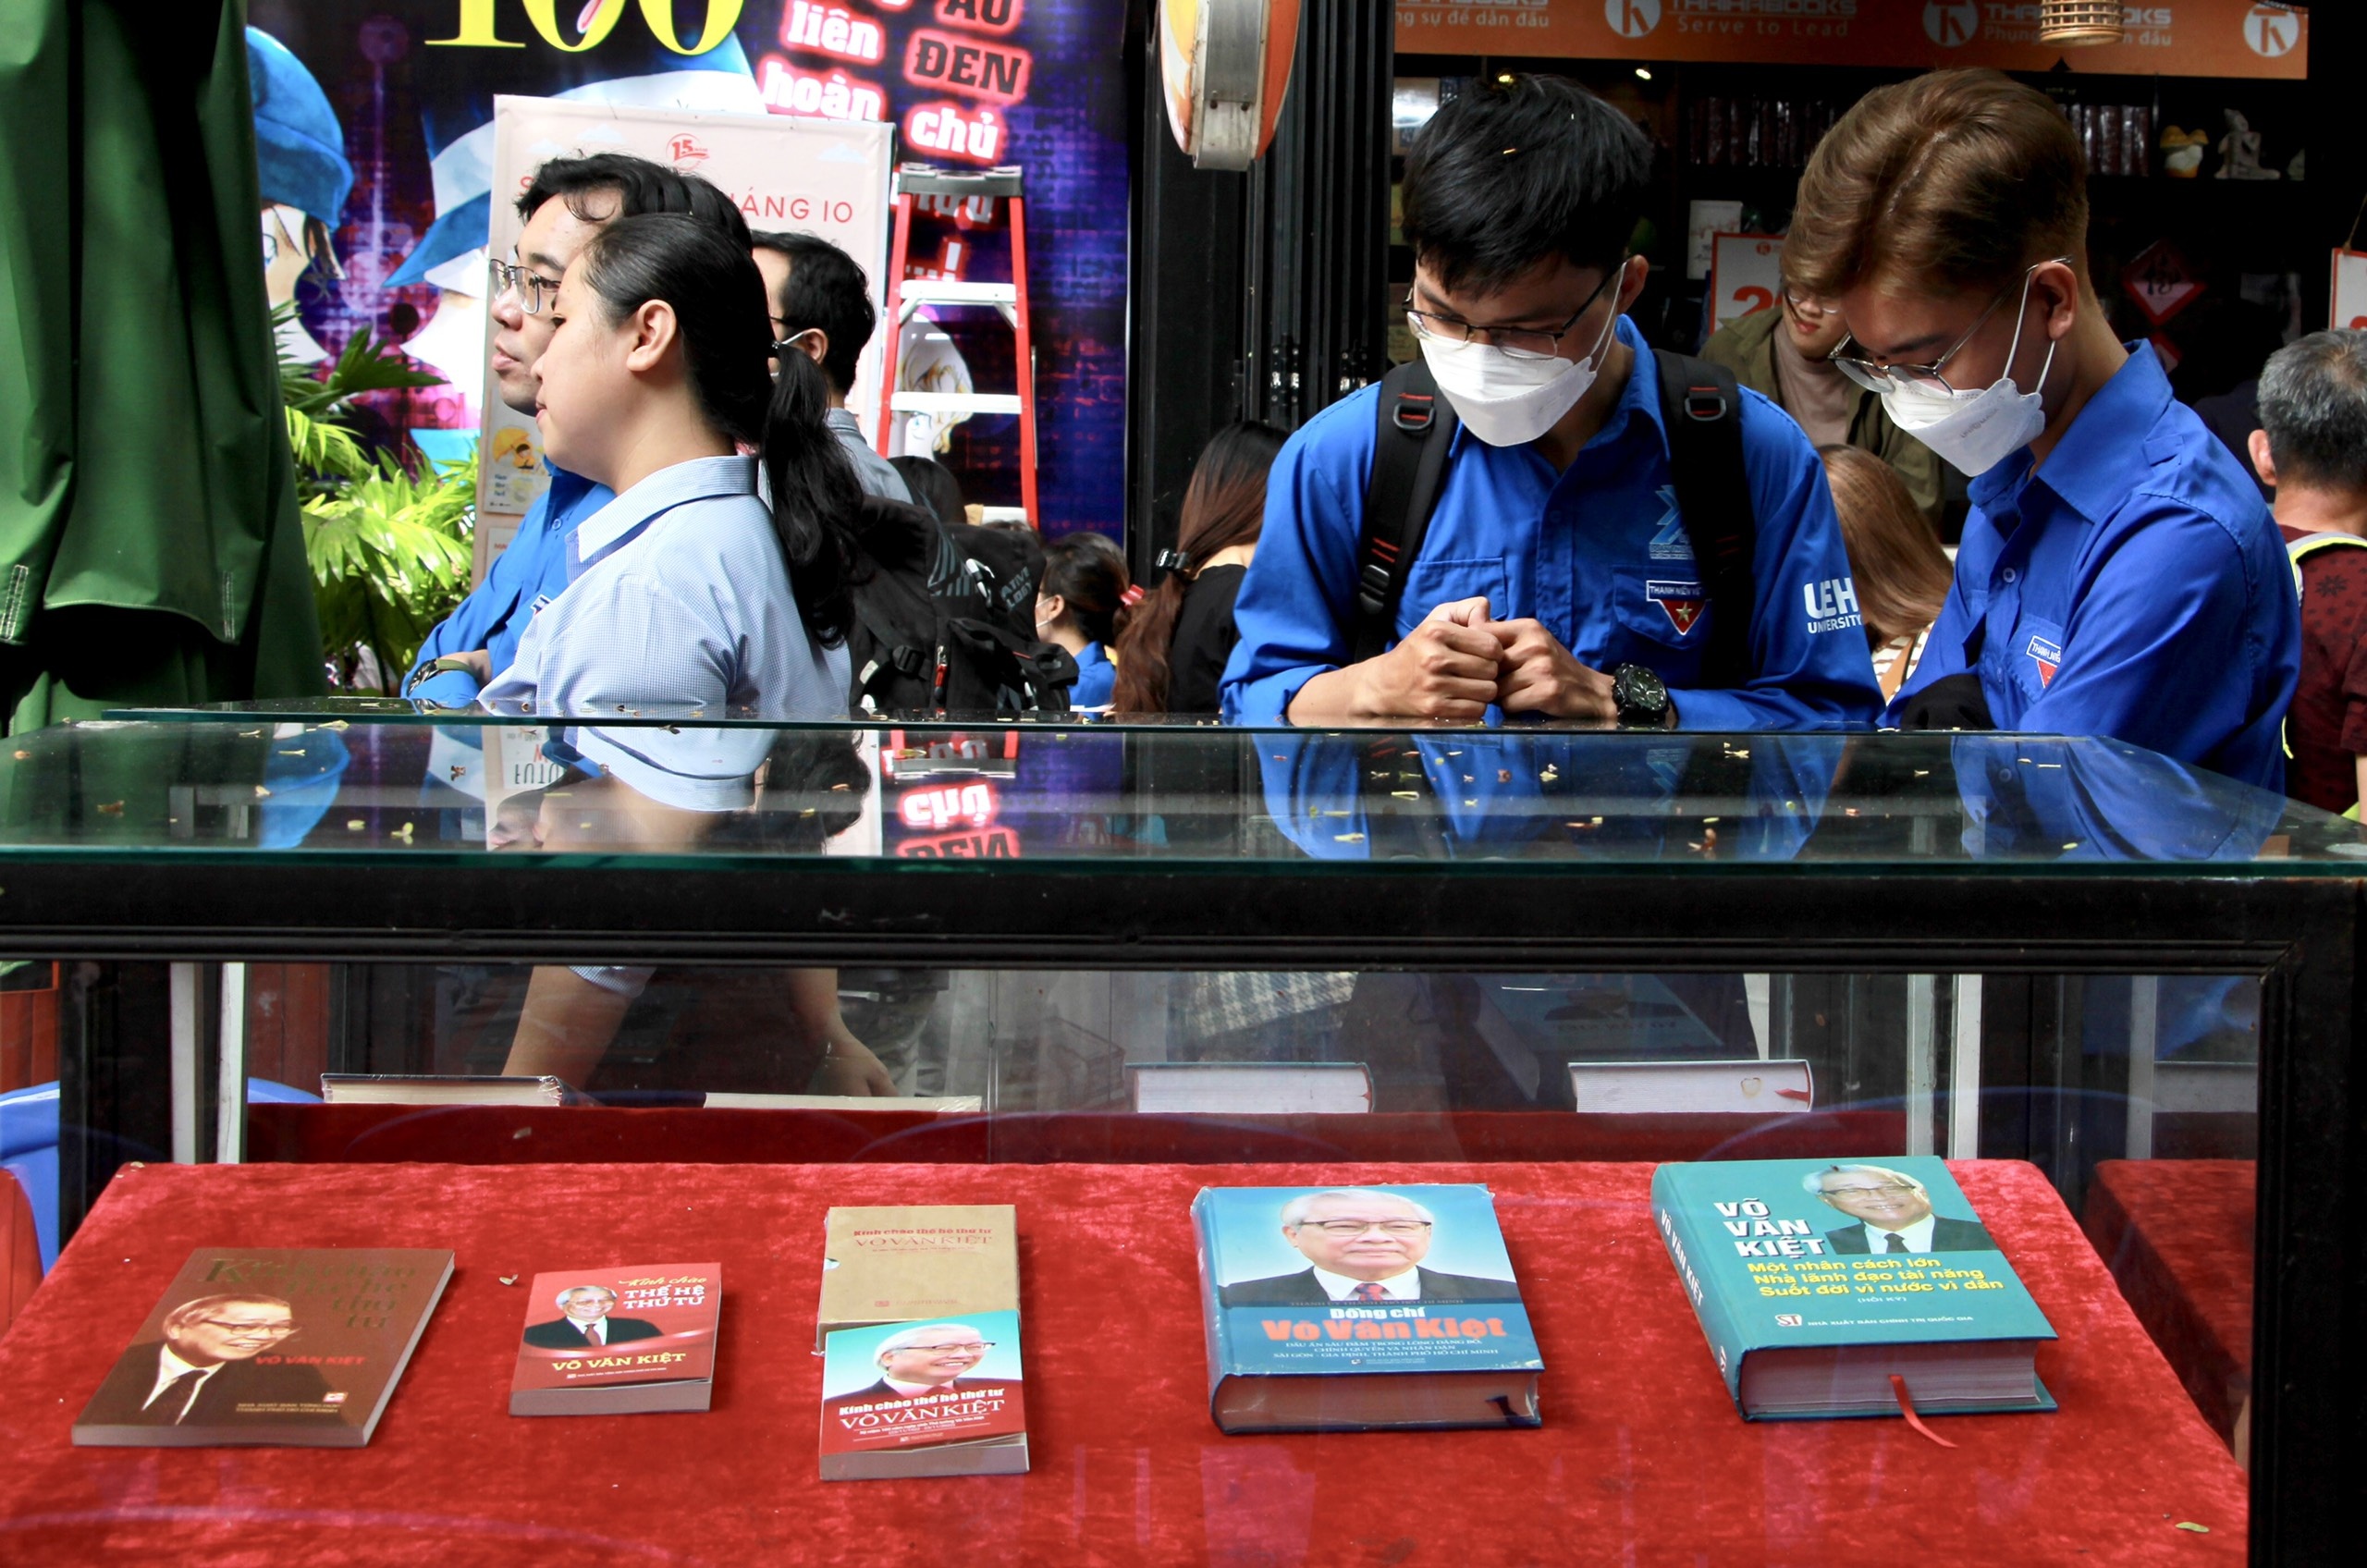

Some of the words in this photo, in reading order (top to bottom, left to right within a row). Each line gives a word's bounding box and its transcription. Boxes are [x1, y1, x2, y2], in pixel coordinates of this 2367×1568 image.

[786, 0, 879, 59] liên
[1677, 15, 1746, 34] Serve
[1758, 18, 1781, 34] to
[1793, 20, 1848, 37] Lead
[914, 38, 1021, 94] ĐEN
[763, 60, 883, 120] hoàn
[911, 106, 999, 159] chủ
[730, 187, 810, 220] ÁNG
[1804, 577, 1859, 619] UEH
[1713, 1197, 1771, 1219] VÕ
[1723, 1217, 1813, 1238] VĂN
[1735, 1236, 1826, 1260] KIỆT
[1748, 1262, 1789, 1274] Một
[1794, 1260, 1847, 1271] nhân
[1851, 1258, 1902, 1269] cách
[1907, 1257, 1942, 1268] lớn
[1753, 1273, 1797, 1284] Nhà
[1801, 1272, 1849, 1283] lãnh
[1853, 1271, 1894, 1283] đạo
[1897, 1269, 1926, 1280] tài
[1931, 1268, 1986, 1280] năng
[624, 1284, 672, 1299] THẾ
[674, 1284, 705, 1296] HỆ
[1759, 1283, 1812, 1296] Suốt
[1816, 1283, 1850, 1295] đời
[1855, 1283, 1875, 1293] vì
[1880, 1280, 1934, 1292] nước
[1938, 1280, 1959, 1291] vì
[1330, 1307, 1388, 1319] Đồng
[1390, 1306, 1426, 1318] chí
[1261, 1318, 1322, 1341] Võ
[1322, 1318, 1411, 1341] Văn
[1414, 1317, 1508, 1340] Kiệt
[255, 1354, 282, 1366] VÕ
[285, 1354, 323, 1366] VĂN
[552, 1359, 582, 1370] VÕ
[586, 1356, 632, 1368] VĂN
[637, 1352, 686, 1365] KIỆT
[839, 1404, 874, 1416] Kính
[875, 1399, 913, 1412] chào
[914, 1394, 940, 1406] thế
[940, 1391, 959, 1403] hệ
[961, 1389, 987, 1401] thứ
[987, 1387, 1005, 1397] tư
[840, 1413, 880, 1430] VÕ
[882, 1405, 939, 1424] VĂN
[941, 1399, 1005, 1417] KIỆT
